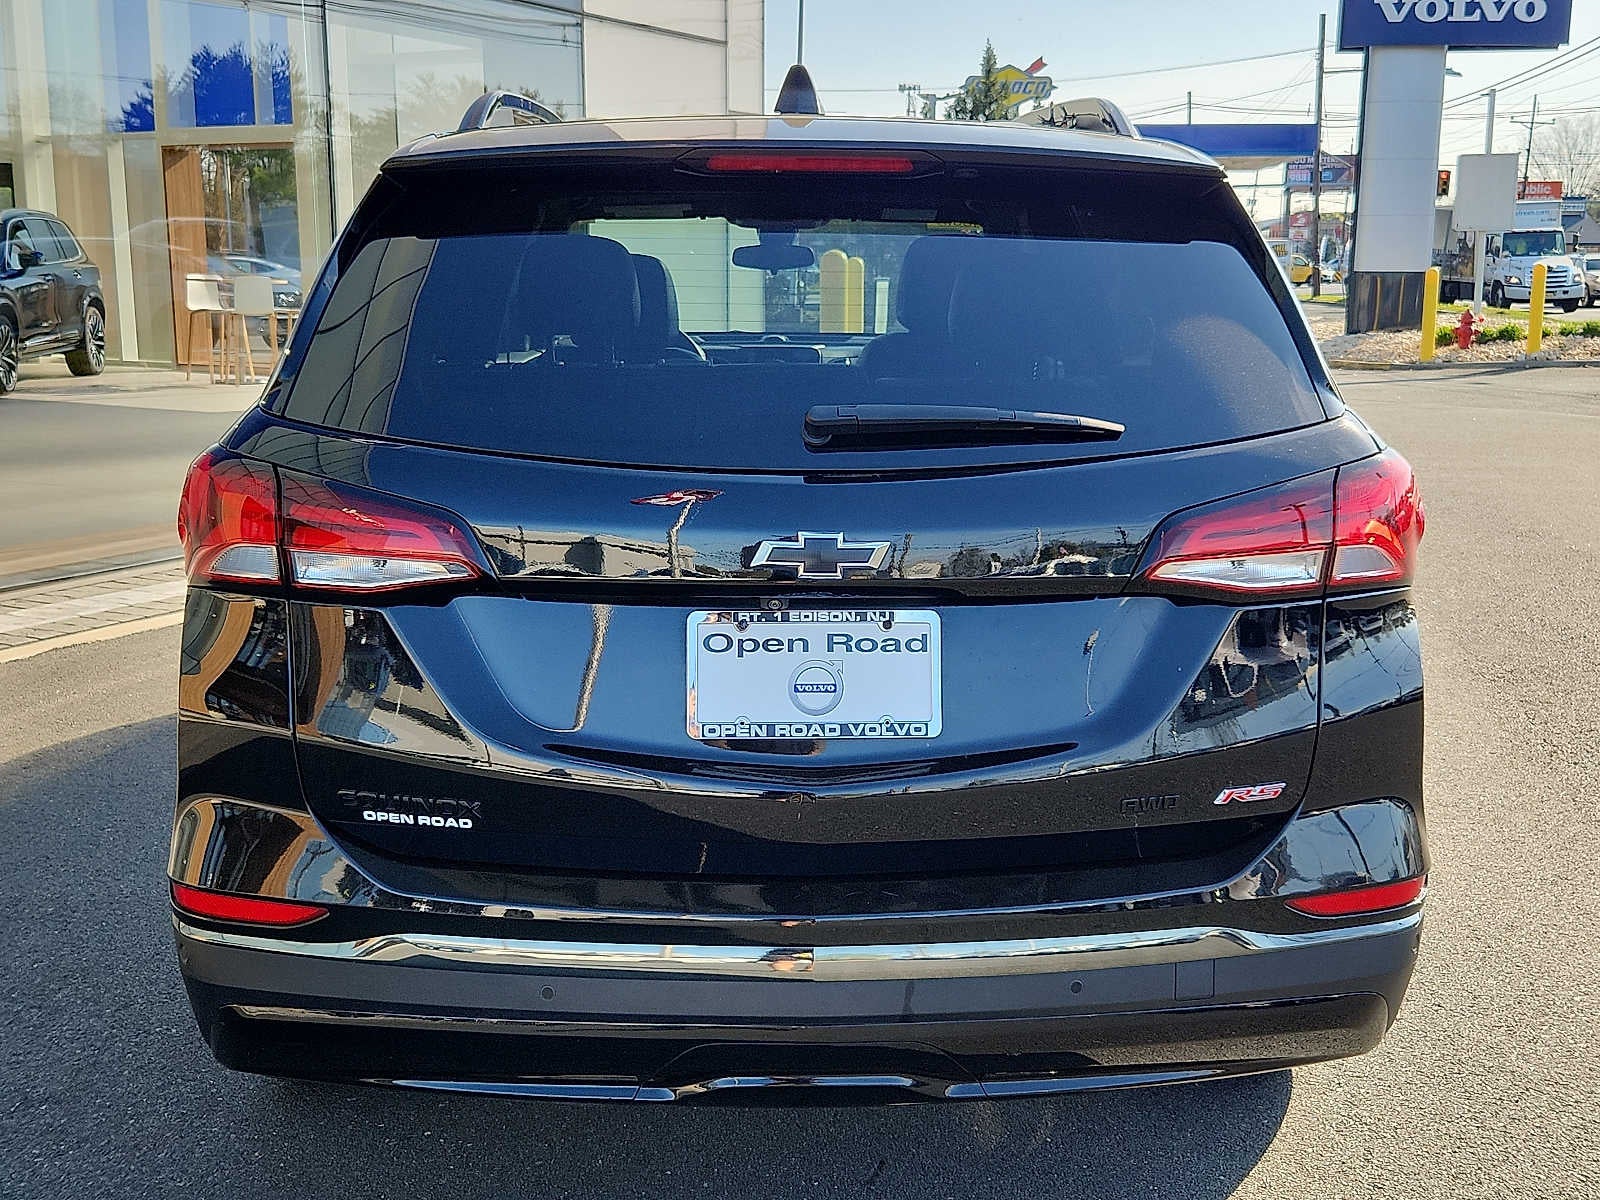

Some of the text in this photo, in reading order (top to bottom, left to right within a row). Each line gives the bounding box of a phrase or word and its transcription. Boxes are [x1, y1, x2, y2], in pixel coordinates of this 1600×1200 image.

[1374, 0, 1548, 23] VOLVO
[738, 611, 891, 623] RT. 1 EDISON, NJ
[702, 633, 928, 658] Open Road
[796, 684, 836, 693] VOLVO
[703, 723, 927, 738] OPEN ROAD VOLVO
[1213, 781, 1287, 805] RS
[362, 810, 473, 829] OPEN ROAD
